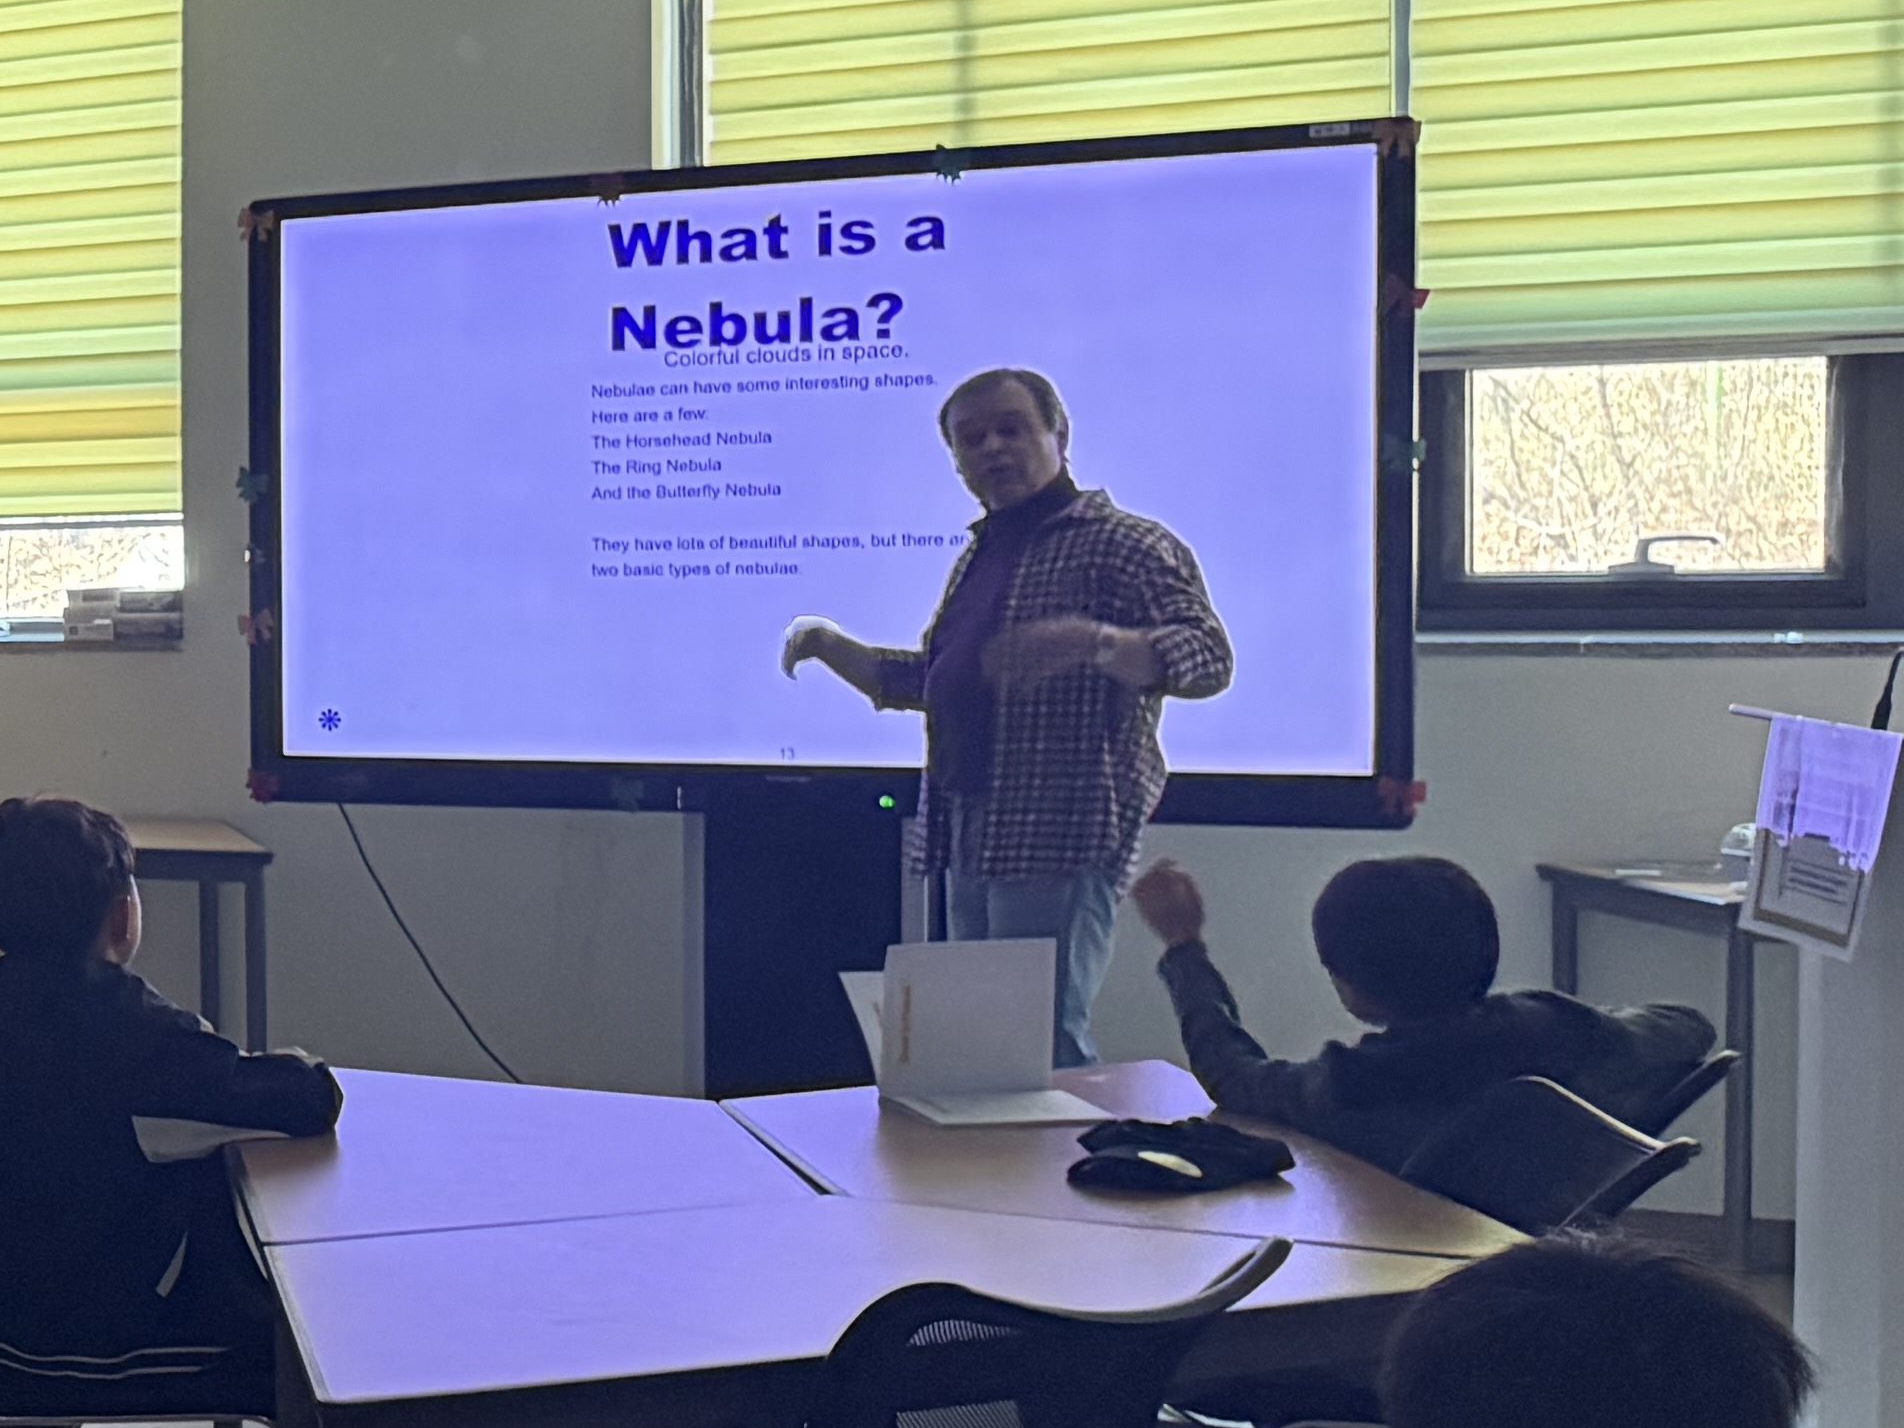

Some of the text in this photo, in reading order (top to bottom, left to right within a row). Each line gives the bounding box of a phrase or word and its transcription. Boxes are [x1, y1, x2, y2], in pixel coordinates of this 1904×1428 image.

[608, 210, 946, 268] What is a
[610, 292, 905, 352] Nebula?
[664, 344, 909, 367] Colorful clouds in space.
[592, 384, 655, 399] Nebulae
[660, 383, 688, 396] can
[694, 380, 732, 394] have
[737, 380, 780, 392] some
[785, 375, 870, 391] interesting
[592, 410, 628, 424] Here
[634, 410, 658, 422] are
[664, 410, 673, 421] a
[592, 431, 772, 449] The Horsehead Nebula
[592, 457, 722, 476] The Ring Nebula
[592, 483, 782, 501] And the Butterfly Nebula
[592, 536, 630, 554] They
[635, 536, 672, 551] have
[677, 536, 704, 550] lots
[709, 535, 725, 550] of
[729, 534, 797, 550] beautiful
[802, 534, 865, 550] shapes,
[871, 533, 896, 548] but
[902, 532, 944, 547] there
[592, 563, 618, 577] two
[624, 562, 663, 577] basic
[668, 562, 710, 580] types
[715, 561, 731, 575] of
